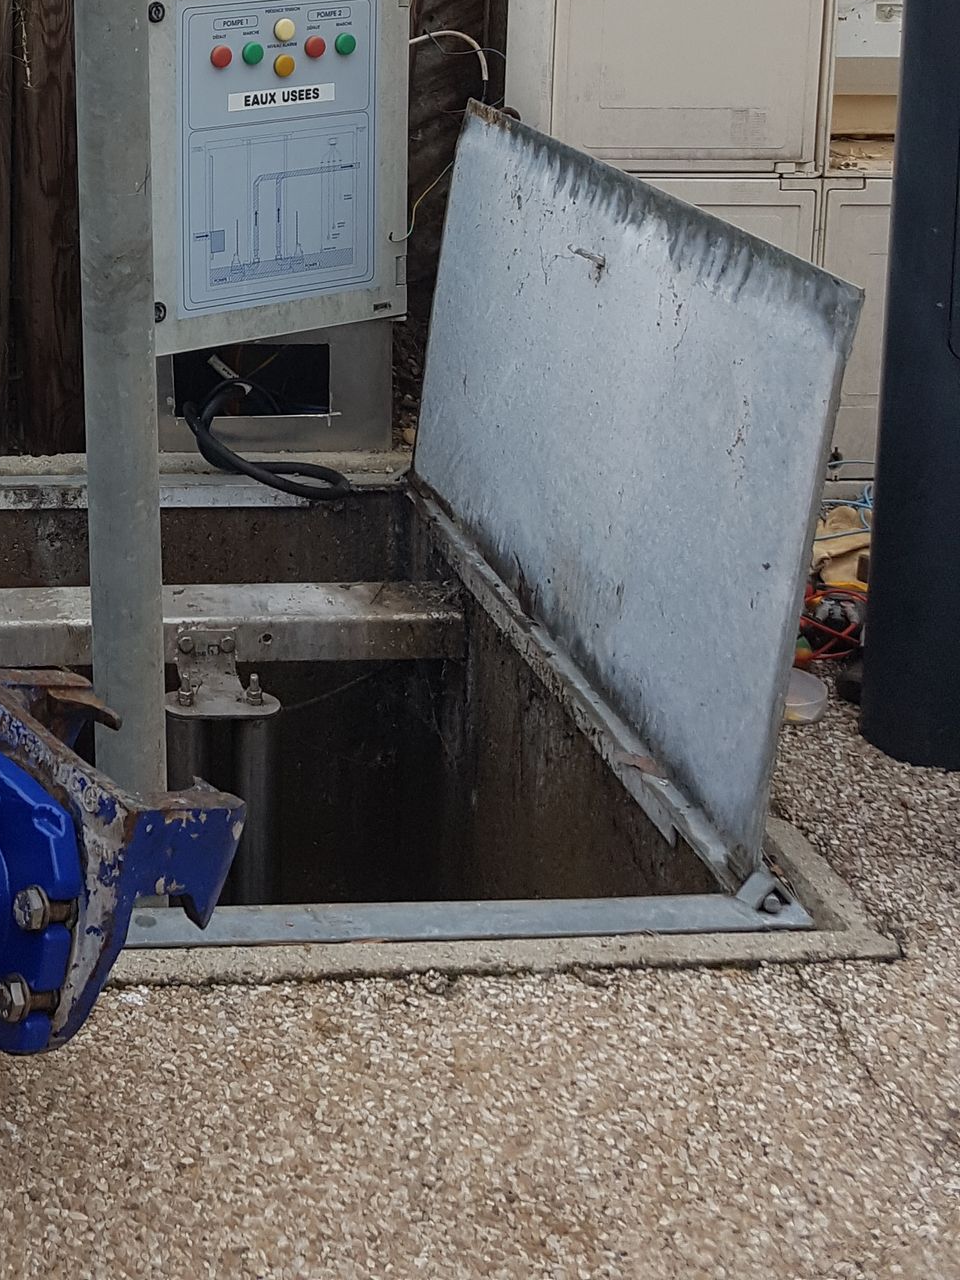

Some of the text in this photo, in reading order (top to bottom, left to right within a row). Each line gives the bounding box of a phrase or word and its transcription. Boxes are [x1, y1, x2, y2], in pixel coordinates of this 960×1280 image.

[316, 10, 337, 18] POMPE
[223, 19, 243, 27] POMPE
[244, 87, 320, 107] EAUX USEES
